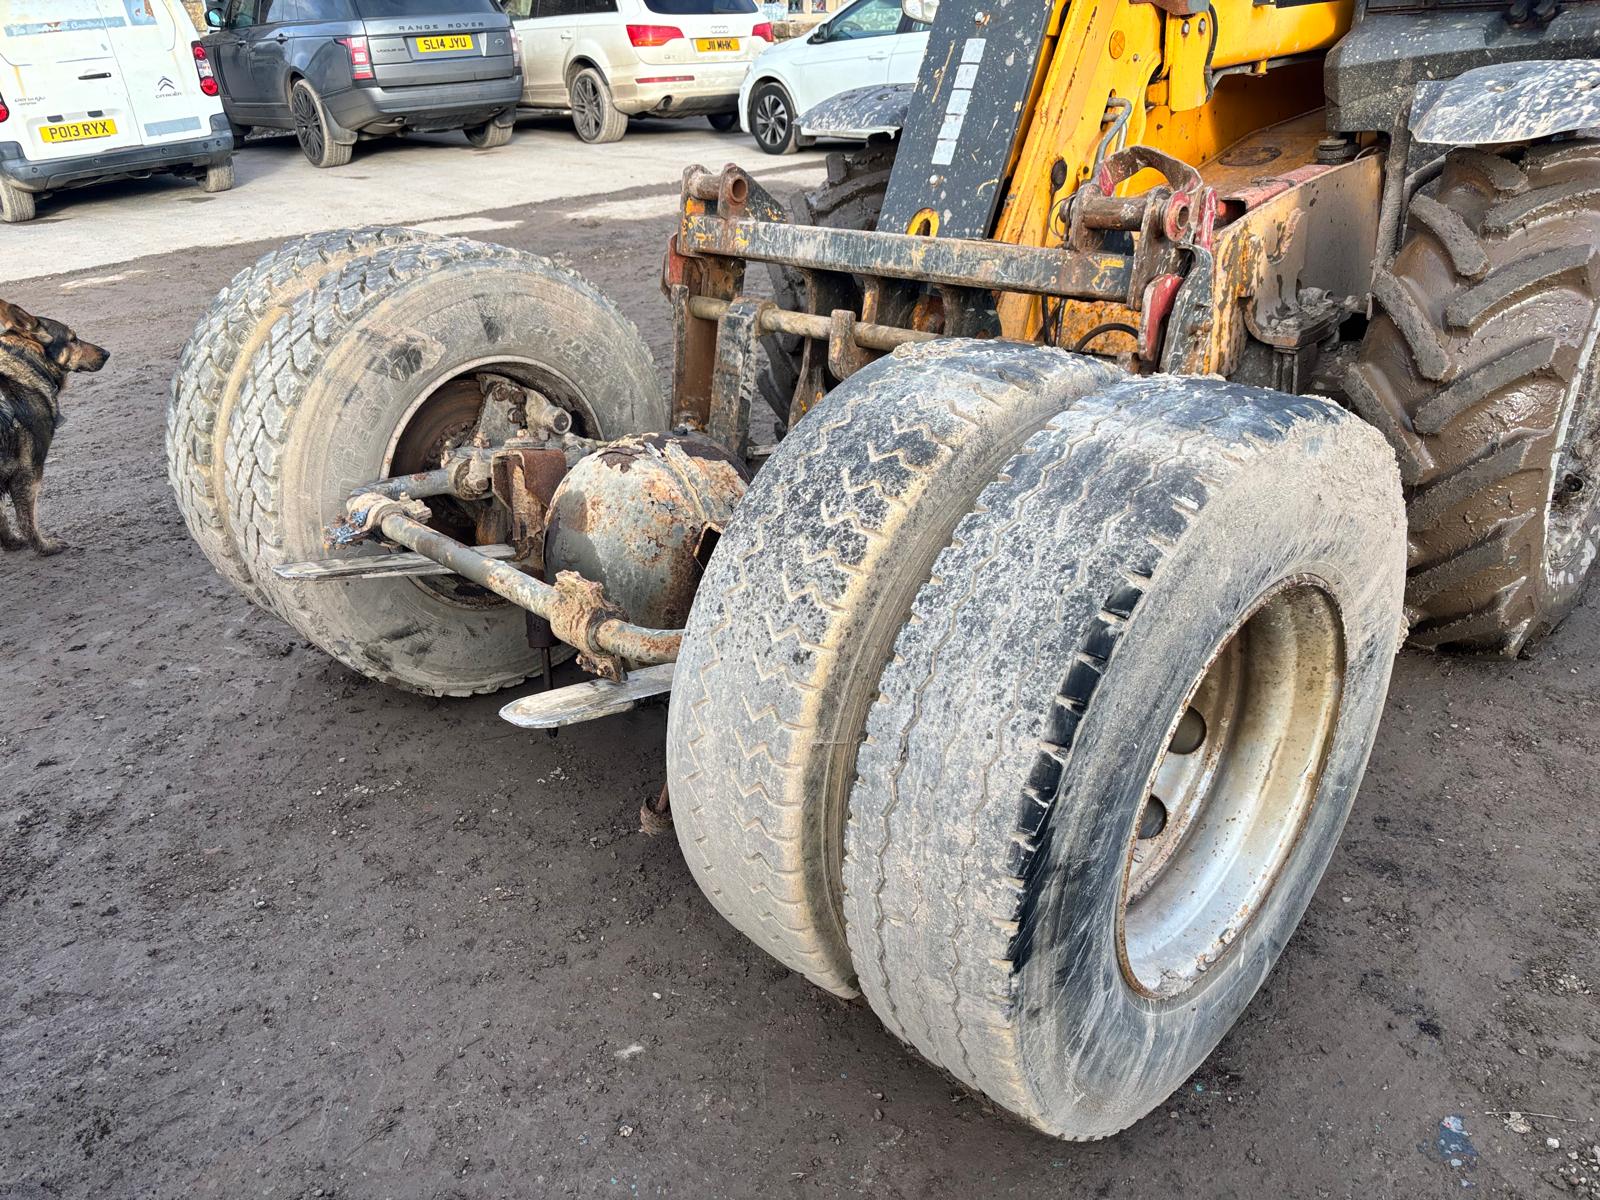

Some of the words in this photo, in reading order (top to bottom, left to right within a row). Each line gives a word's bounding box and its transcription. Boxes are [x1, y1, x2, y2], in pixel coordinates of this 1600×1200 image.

[447, 21, 484, 29] ROVER
[423, 38, 446, 50] SL14
[448, 37, 467, 49] JYU
[48, 124, 80, 139] PO13
[81, 121, 109, 136] RYX
